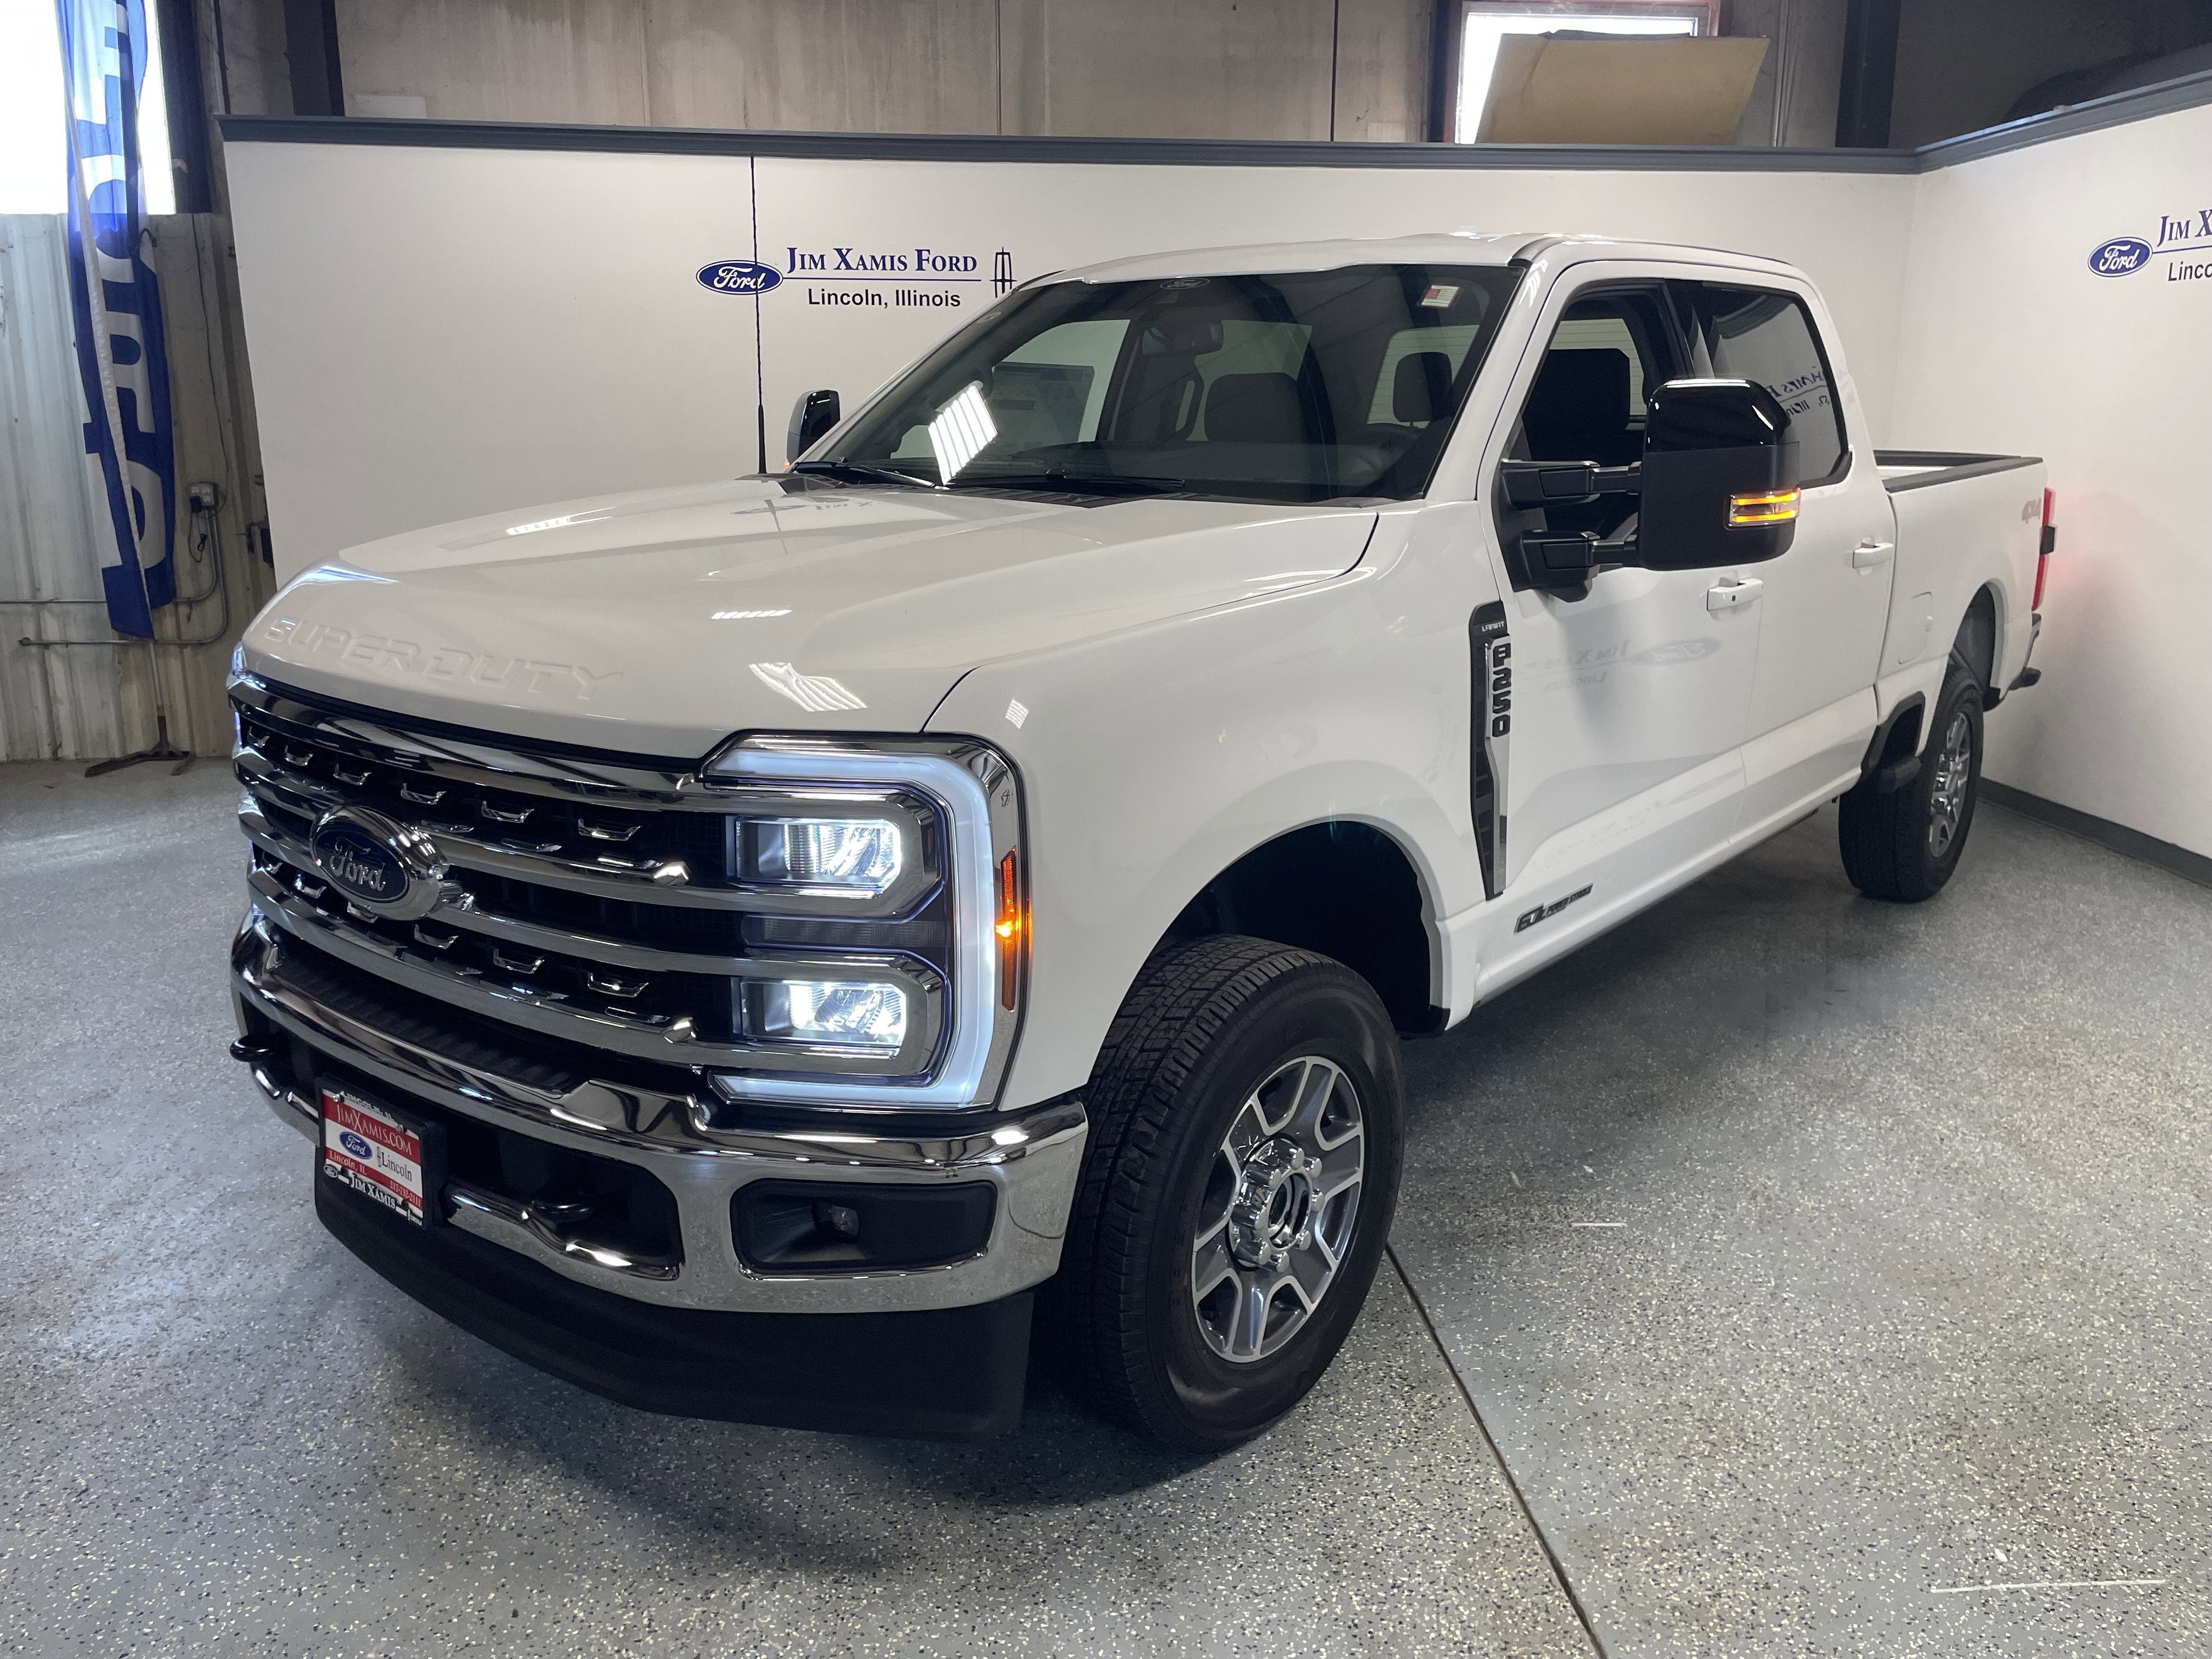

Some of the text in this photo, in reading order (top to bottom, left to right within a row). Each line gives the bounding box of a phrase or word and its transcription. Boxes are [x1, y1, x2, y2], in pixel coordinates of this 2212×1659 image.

[2157, 216, 2192, 247] JIM
[786, 247, 978, 274] JIM XAMIS FORD
[2099, 245, 2140, 271] Ford
[713, 264, 766, 290] Ford
[808, 288, 961, 309] Lincoln, Illinois
[1481, 620, 1505, 632] LARIAT
[264, 616, 624, 701] SUPER DUTY
[1492, 642, 1512, 737] F250
[329, 836, 386, 891] Ford
[336, 1104, 413, 1156] JIMXAMIS.COM
[346, 1135, 366, 1156] Ford
[329, 1150, 358, 1171] Lincoln,
[359, 1164, 368, 1176] IL
[381, 1152, 413, 1182] Lincoln
[351, 1172, 396, 1209] JIM XAMIS
